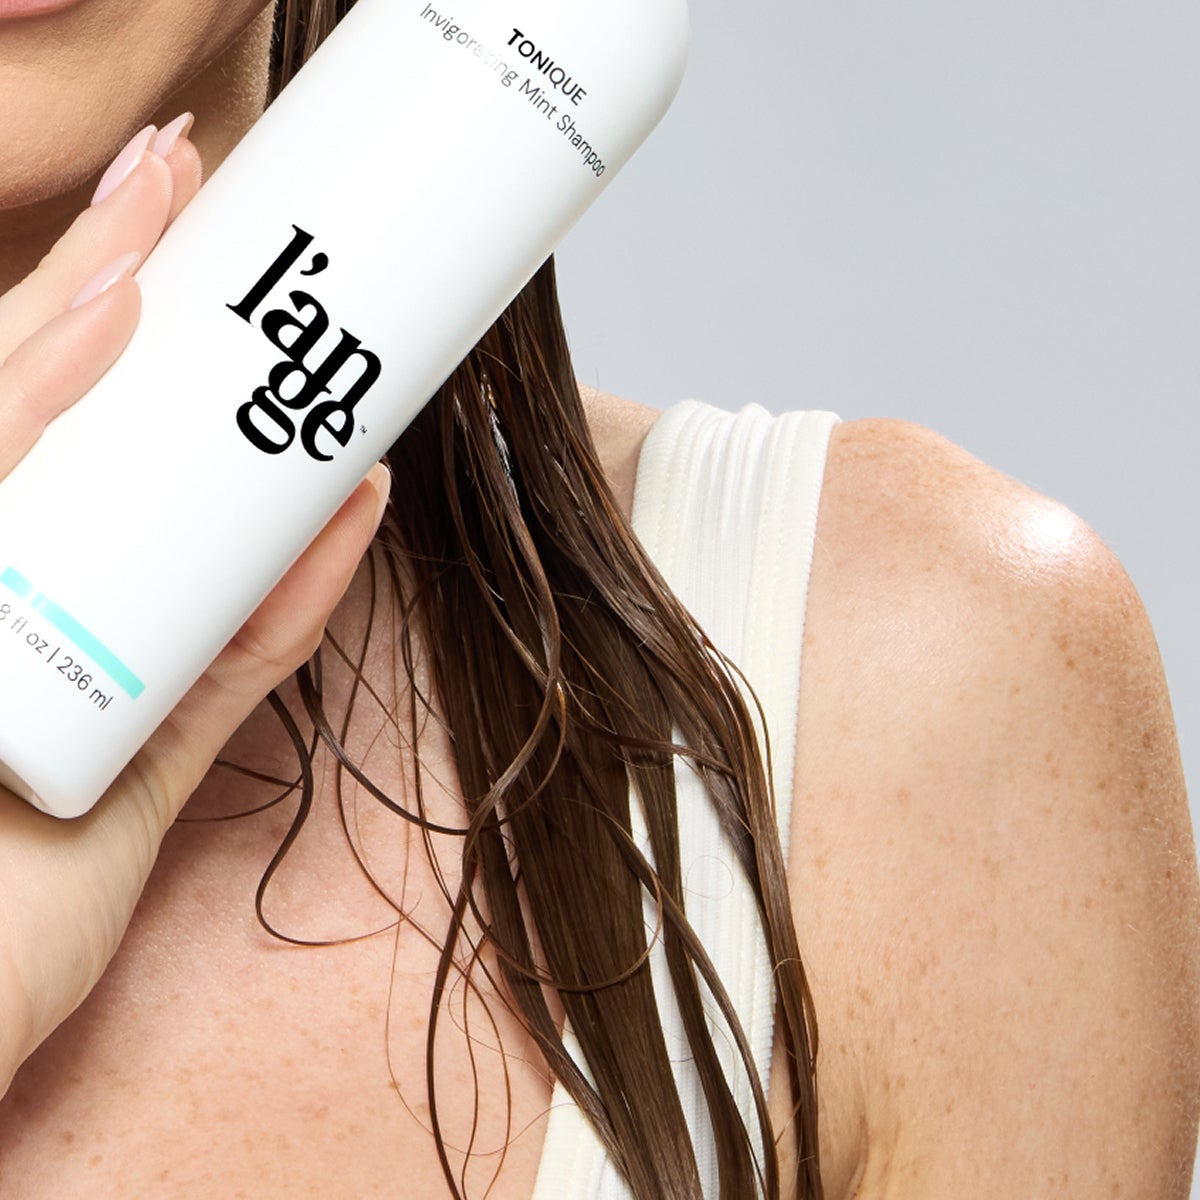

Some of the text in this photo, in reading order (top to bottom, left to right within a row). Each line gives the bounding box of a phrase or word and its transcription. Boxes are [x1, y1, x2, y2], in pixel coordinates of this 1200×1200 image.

[507, 28, 588, 106] TONIQUE
[518, 78, 558, 120] Mint
[556, 114, 606, 177] Shampoo
[10, 616, 28, 634] fl
[26, 633, 49, 654] oz
[56, 655, 93, 691] 236
[89, 689, 114, 711] ml
